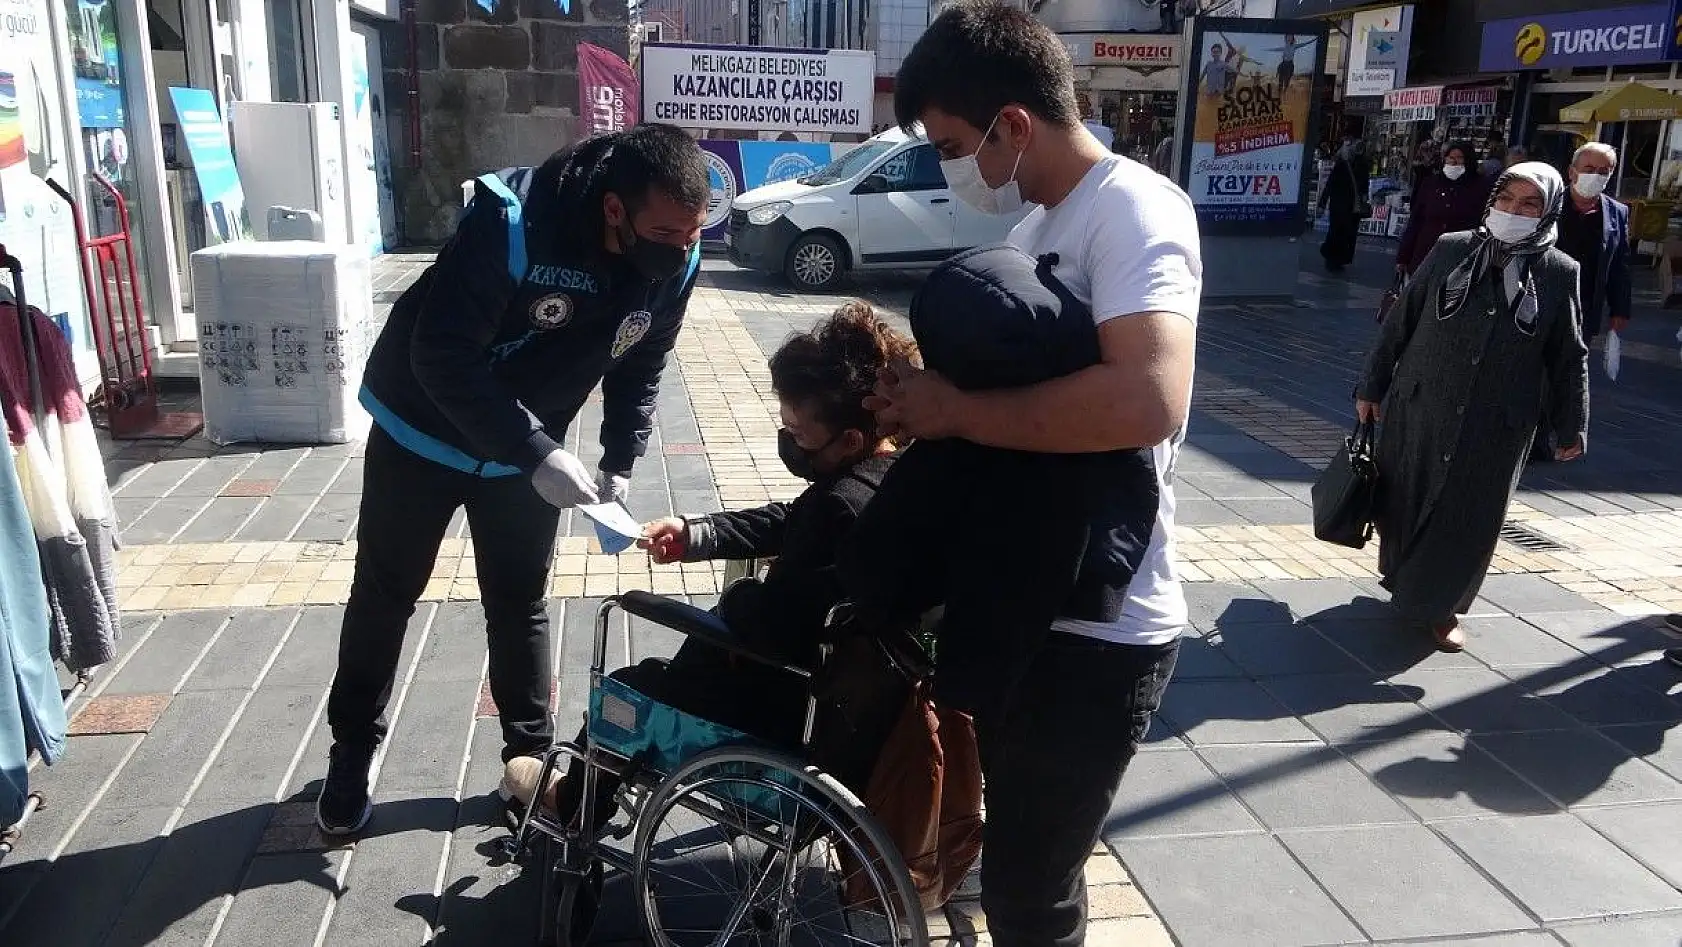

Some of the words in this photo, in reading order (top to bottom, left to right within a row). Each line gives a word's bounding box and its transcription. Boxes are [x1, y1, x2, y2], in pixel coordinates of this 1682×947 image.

[1094, 42, 1172, 60] Başyazıcı
[691, 54, 756, 74] MELİKGAZİ
[759, 57, 827, 77] BELEDİYESİ
[673, 75, 777, 100] KAZANCILAR
[782, 79, 843, 105] ÇARŞISI
[655, 101, 697, 120] CEPHE
[701, 104, 791, 123] RESTORASYON
[794, 107, 860, 127] ÇALIŞMASI
[1218, 141, 1237, 154] %5
[1241, 132, 1290, 150] İNDİRİM
[527, 264, 598, 294] KAYSER
